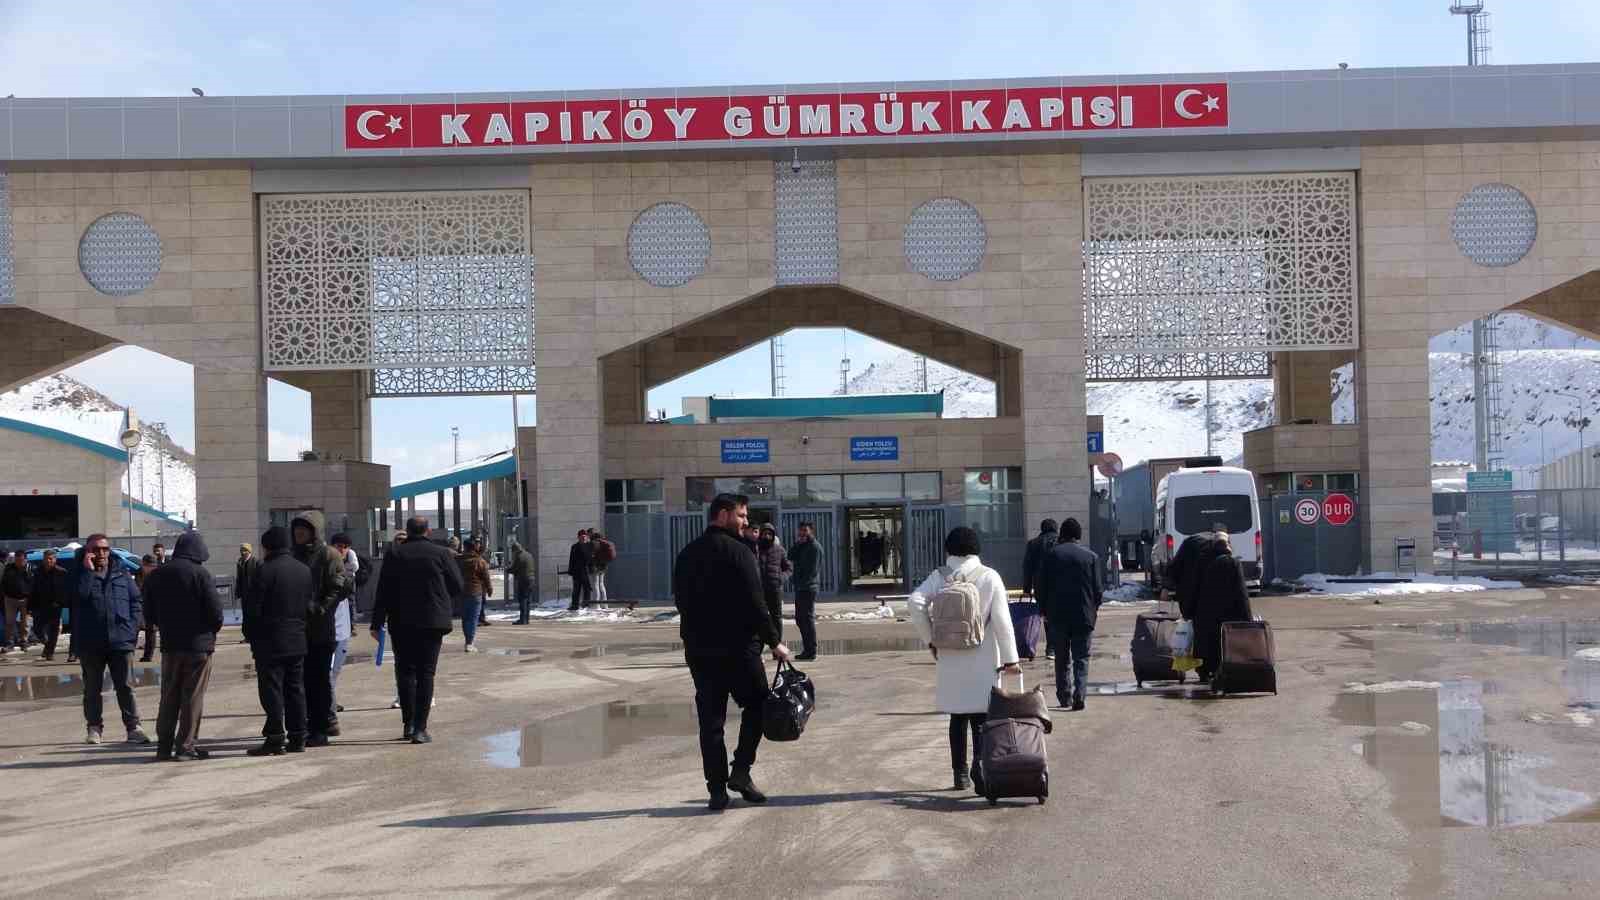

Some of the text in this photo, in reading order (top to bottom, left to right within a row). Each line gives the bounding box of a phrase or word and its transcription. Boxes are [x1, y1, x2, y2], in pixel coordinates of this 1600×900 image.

[441, 92, 1133, 144] KAPIKÖY GÜMRÜK KAPISI
[1301, 507, 1315, 516] 30
[1325, 503, 1351, 515] DUR
